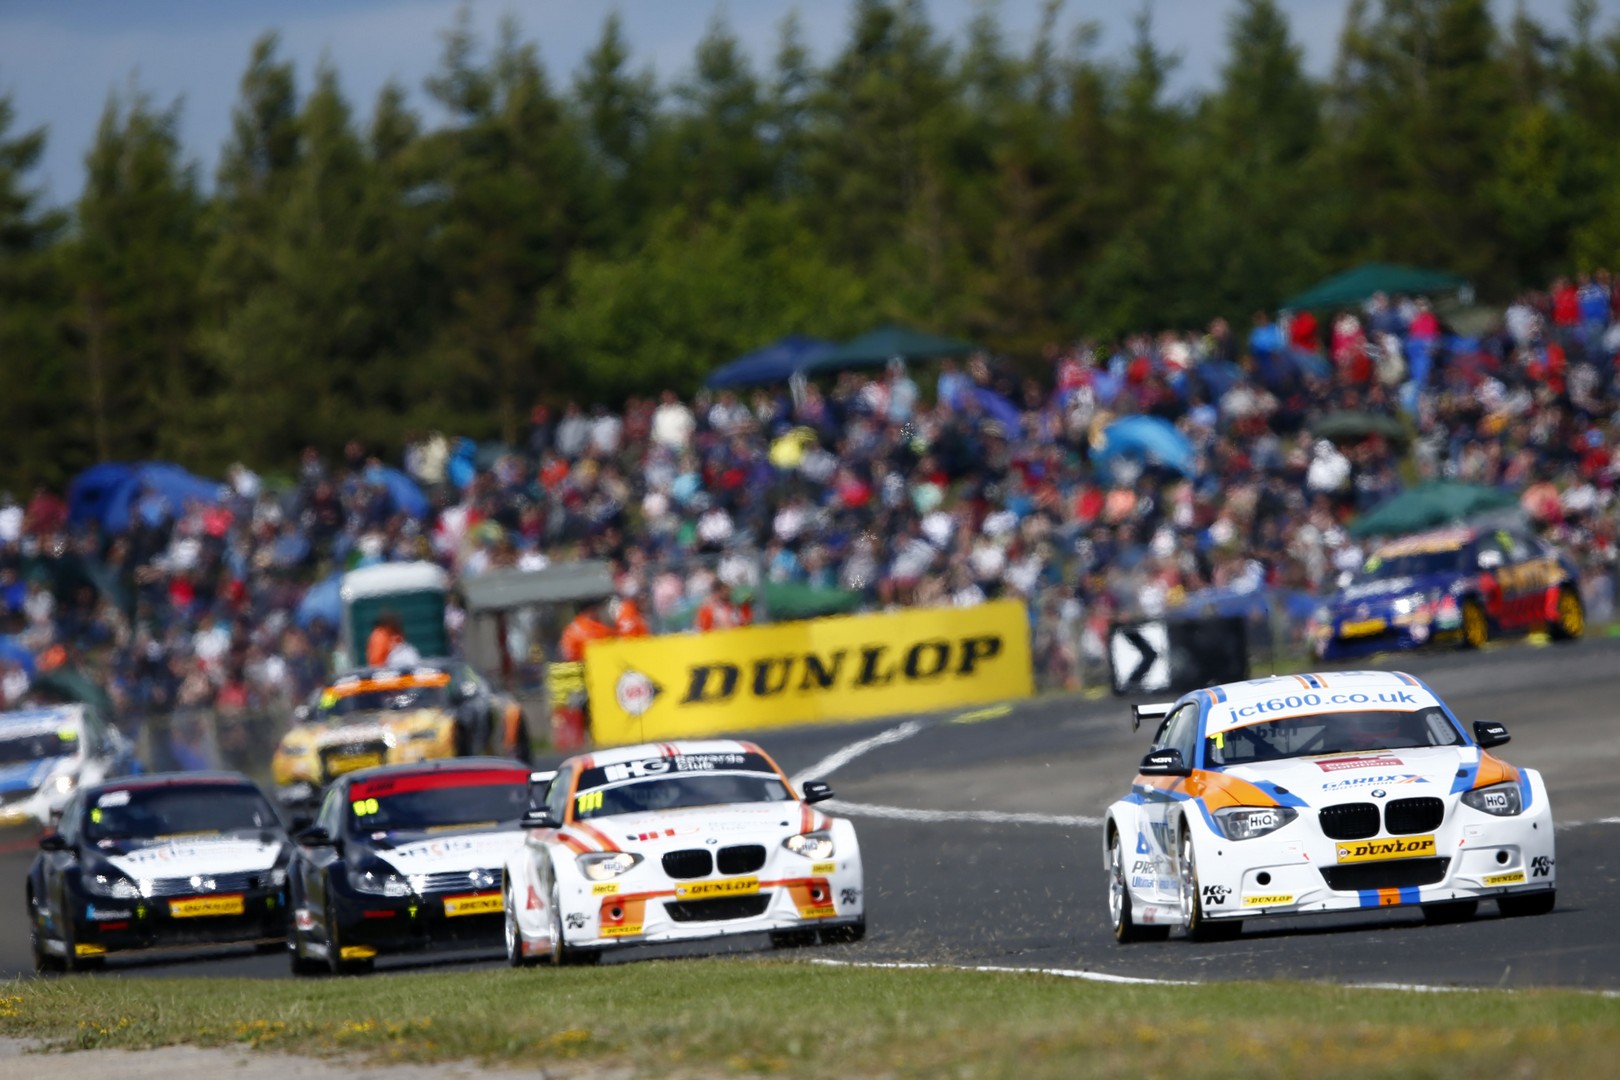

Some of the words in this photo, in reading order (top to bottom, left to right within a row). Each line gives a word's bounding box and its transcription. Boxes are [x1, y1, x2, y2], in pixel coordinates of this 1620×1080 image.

[682, 636, 1001, 705] DUNLOP
[1229, 690, 1417, 724] jct600.co.uk
[674, 753, 745, 765] Rewards
[604, 757, 670, 782] IHG
[578, 791, 603, 813] 111
[1486, 794, 1506, 807] HiQ
[1250, 814, 1272, 826] HiQ
[1354, 841, 1433, 856] DUNLOP
[1490, 874, 1523, 883] DUNLOP
[594, 885, 617, 893] Hertz
[691, 880, 758, 894] DUNLOP
[1251, 895, 1293, 904] DUNLOP
